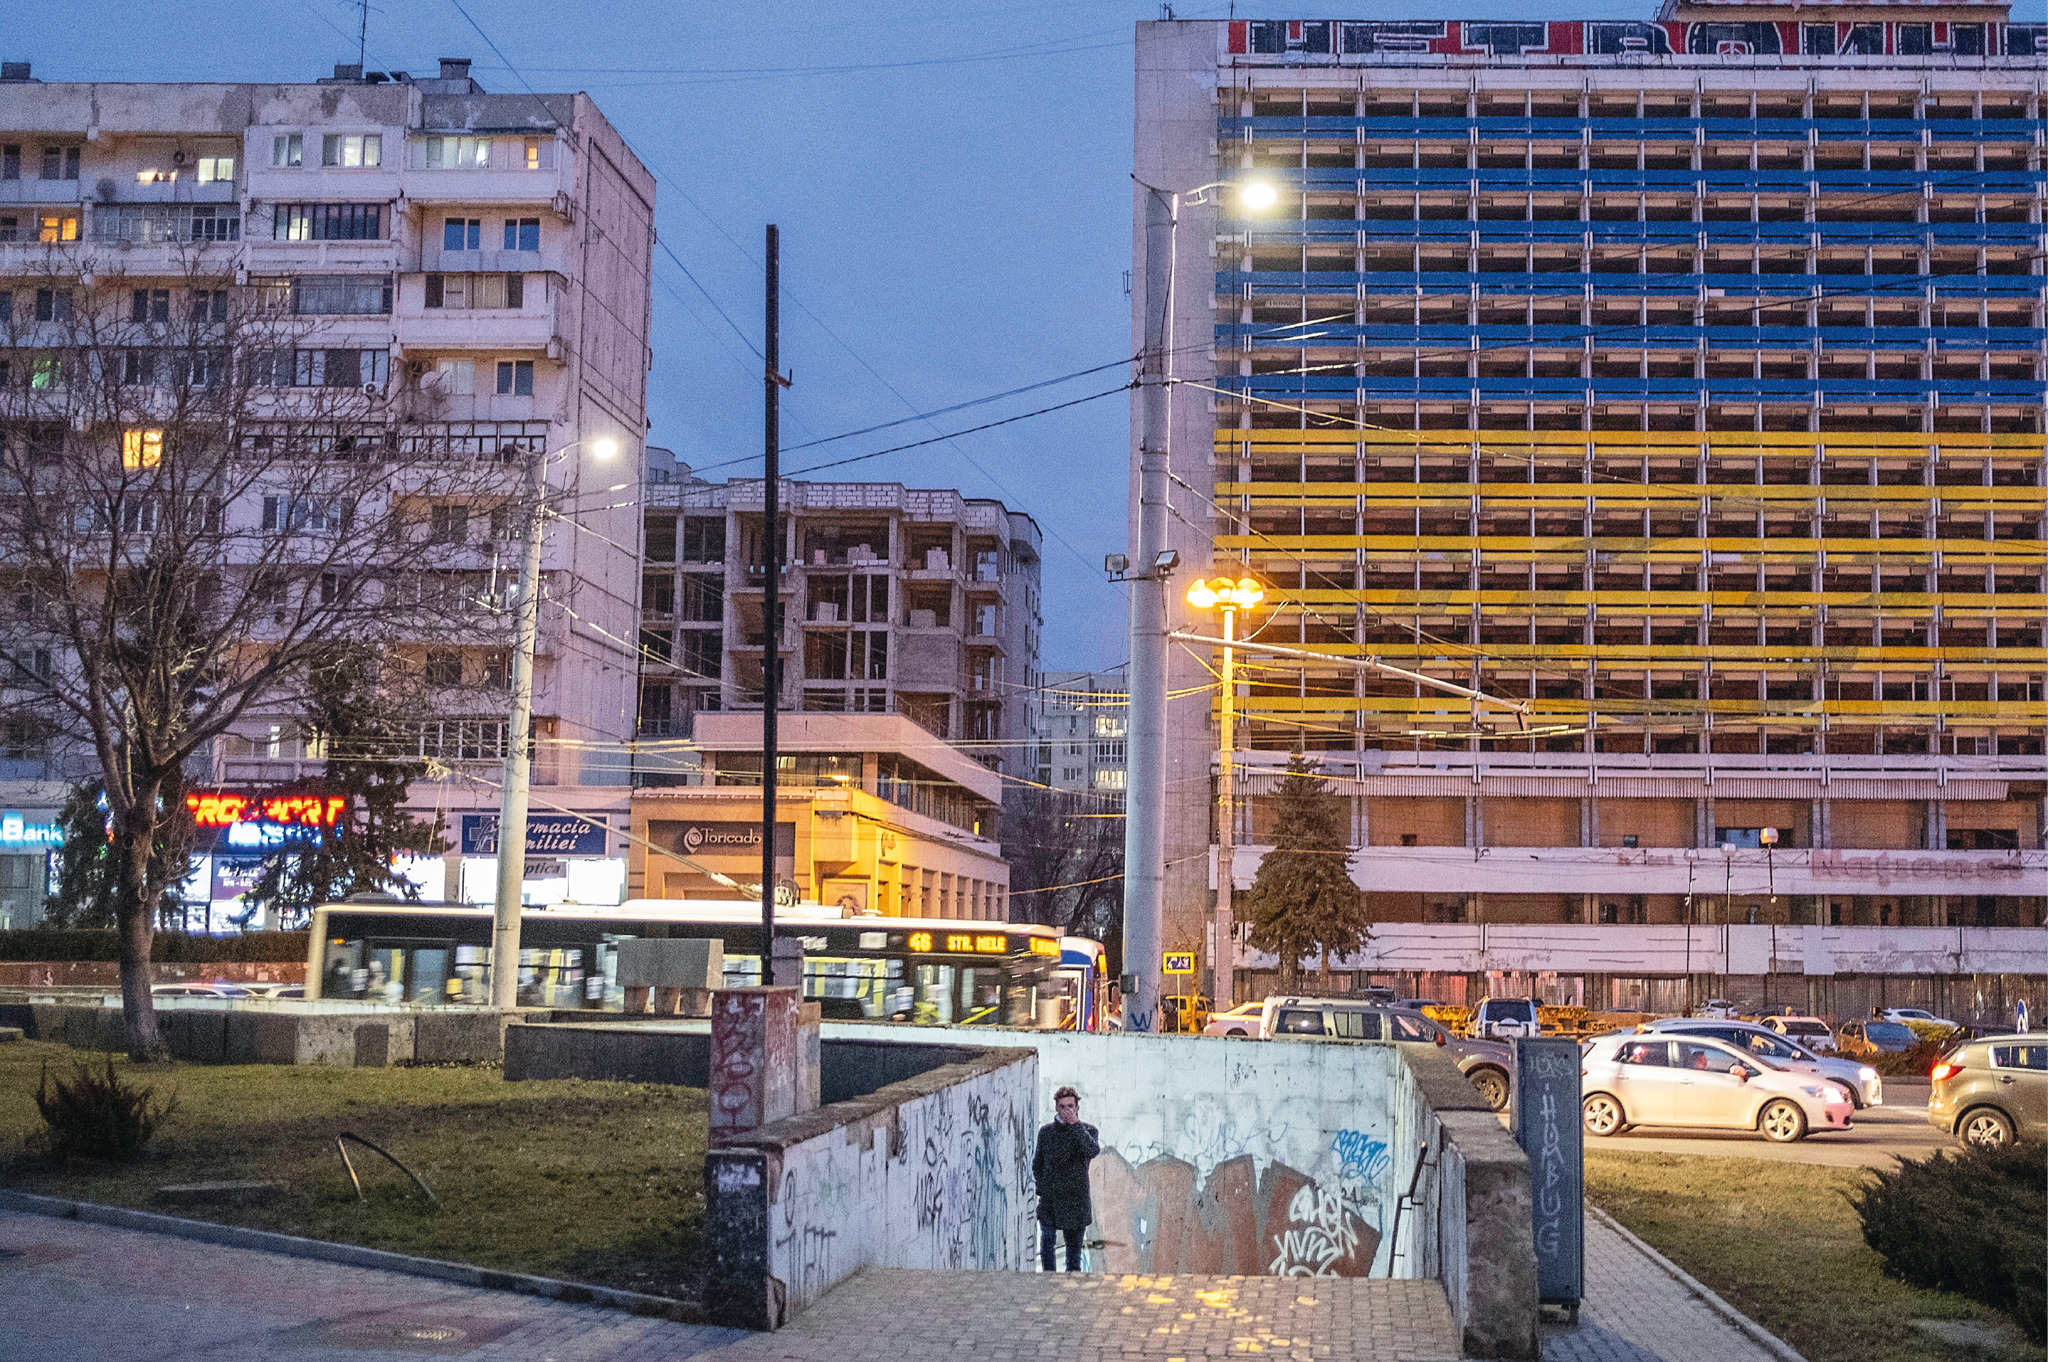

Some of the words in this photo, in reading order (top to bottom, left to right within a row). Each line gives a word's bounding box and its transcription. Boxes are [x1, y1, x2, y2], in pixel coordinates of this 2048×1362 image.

[0, 812, 64, 846] Bank
[497, 817, 591, 834] rmacia
[524, 834, 577, 850] miliei
[701, 828, 761, 844] Toricado
[524, 861, 561, 877] ptica
[909, 932, 932, 951] 46
